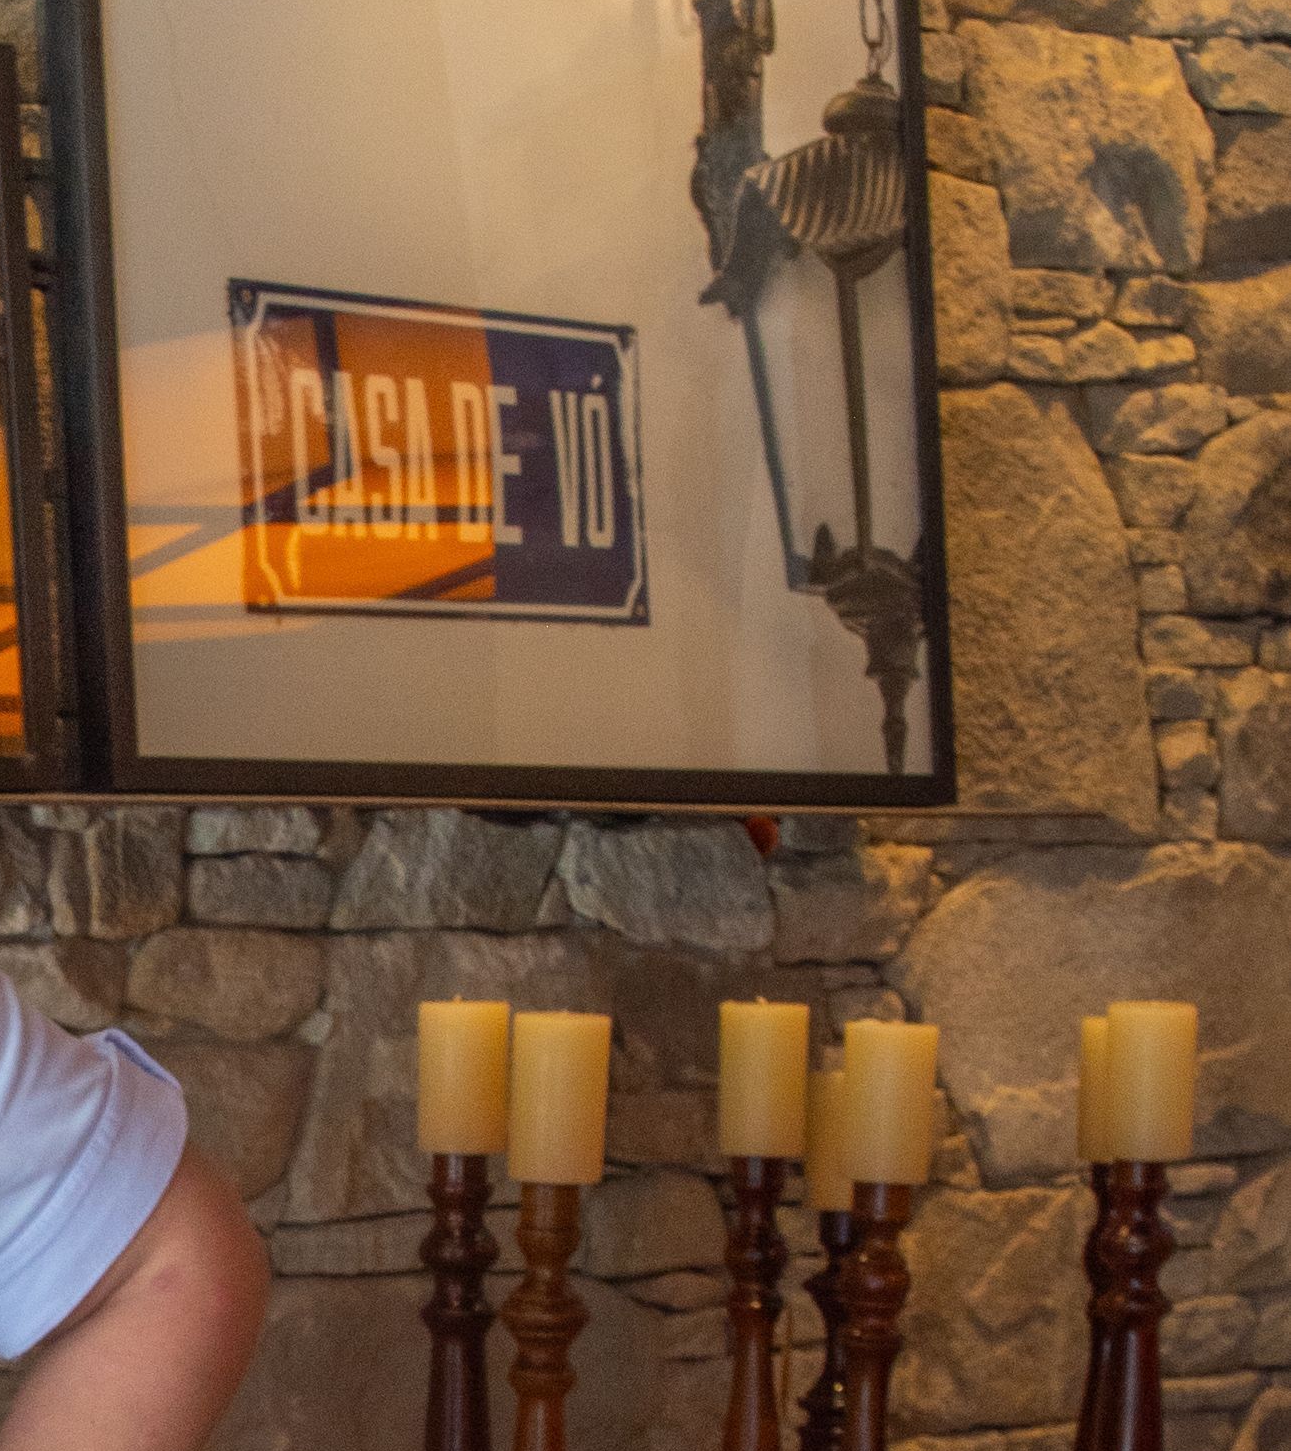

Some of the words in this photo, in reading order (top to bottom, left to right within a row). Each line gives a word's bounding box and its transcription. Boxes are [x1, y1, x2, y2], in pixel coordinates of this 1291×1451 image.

[289, 367, 439, 541] CASA
[450, 381, 524, 546] DE
[547, 373, 616, 549] VÓ
